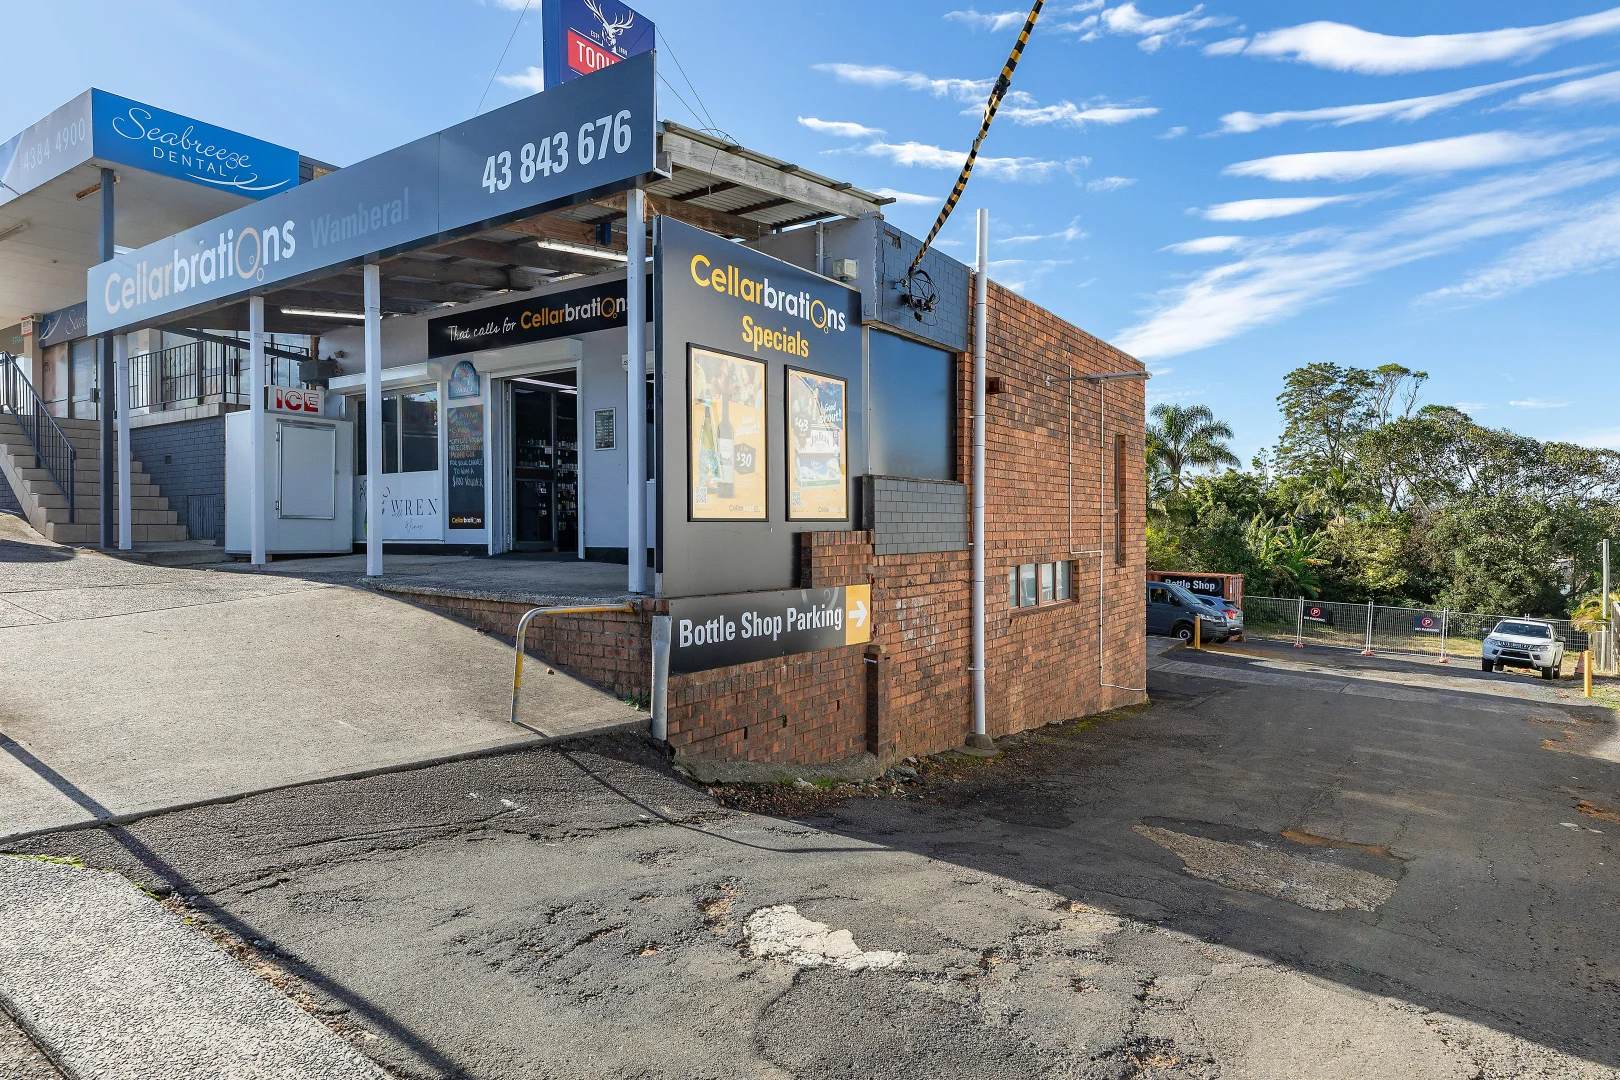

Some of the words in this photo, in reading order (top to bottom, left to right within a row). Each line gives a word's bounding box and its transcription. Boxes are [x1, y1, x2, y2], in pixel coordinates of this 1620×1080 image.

[24, 138, 50, 172] 4384
[56, 118, 85, 154] 4900
[112, 107, 252, 170] Seabreeze
[482, 150, 512, 194] 43
[520, 131, 568, 184] 843
[577, 109, 632, 165] 676
[153, 145, 226, 177] DENTAL
[104, 219, 296, 314] Cellarbrations
[310, 186, 410, 249] Wamberal
[690, 254, 846, 333] Cellarbrations
[448, 325, 471, 342] That
[474, 322, 500, 337] calls
[502, 316, 516, 336] for
[520, 296, 628, 329] Cellarbration
[742, 315, 809, 358] Specials
[276, 389, 319, 412] ICE
[736, 452, 752, 468] $30
[391, 498, 438, 516] WREN
[1192, 580, 1216, 592] Shop
[679, 615, 736, 648] Bottle
[741, 612, 782, 642] Shop
[786, 604, 843, 632] Parking
